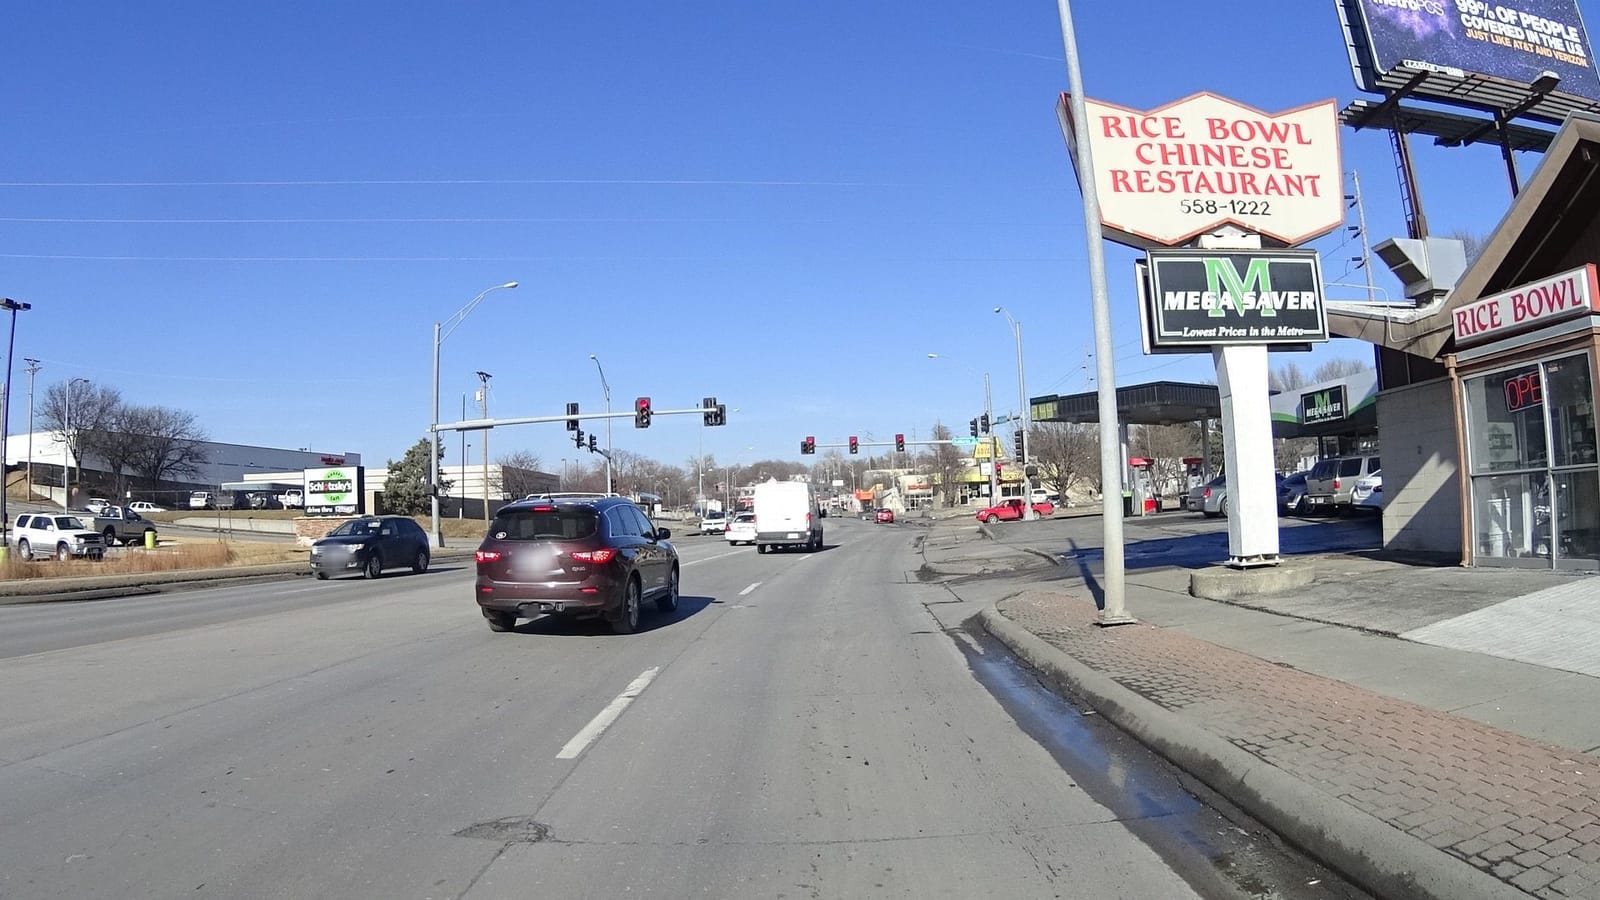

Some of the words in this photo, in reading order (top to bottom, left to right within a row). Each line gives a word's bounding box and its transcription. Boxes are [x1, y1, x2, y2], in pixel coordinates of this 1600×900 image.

[1455, 0, 1495, 19] 99%
[1495, 6, 1518, 25] OF
[1518, 11, 1581, 44] PEOPLE
[1460, 13, 1525, 40] COVERED
[1525, 29, 1541, 46] IN
[1540, 34, 1566, 52] THE
[1565, 41, 1587, 58] U.S.
[1465, 28, 1489, 42] JUST
[1490, 34, 1513, 48] LIKE
[1513, 40, 1535, 53] AT&T
[1535, 45, 1554, 58] AND
[1100, 115, 1185, 139] RICE
[1206, 117, 1312, 145] BOWL
[1135, 143, 1293, 170] CHINESE
[1109, 169, 1320, 197] RESTAURANT
[1180, 198, 1271, 216] 558-1222
[1164, 291, 1235, 311] MEGA
[1241, 291, 1316, 310] SAVER
[1202, 257, 1277, 317] M
[1455, 301, 1502, 337] RICE
[1510, 278, 1582, 322] BOWL
[1182, 327, 1217, 337] Lowest
[1217, 326, 1247, 337] Prices
[1249, 327, 1259, 336] in
[1260, 326, 1276, 336] the
[1276, 326, 1304, 336] Metro
[1506, 372, 1543, 409] OPE
